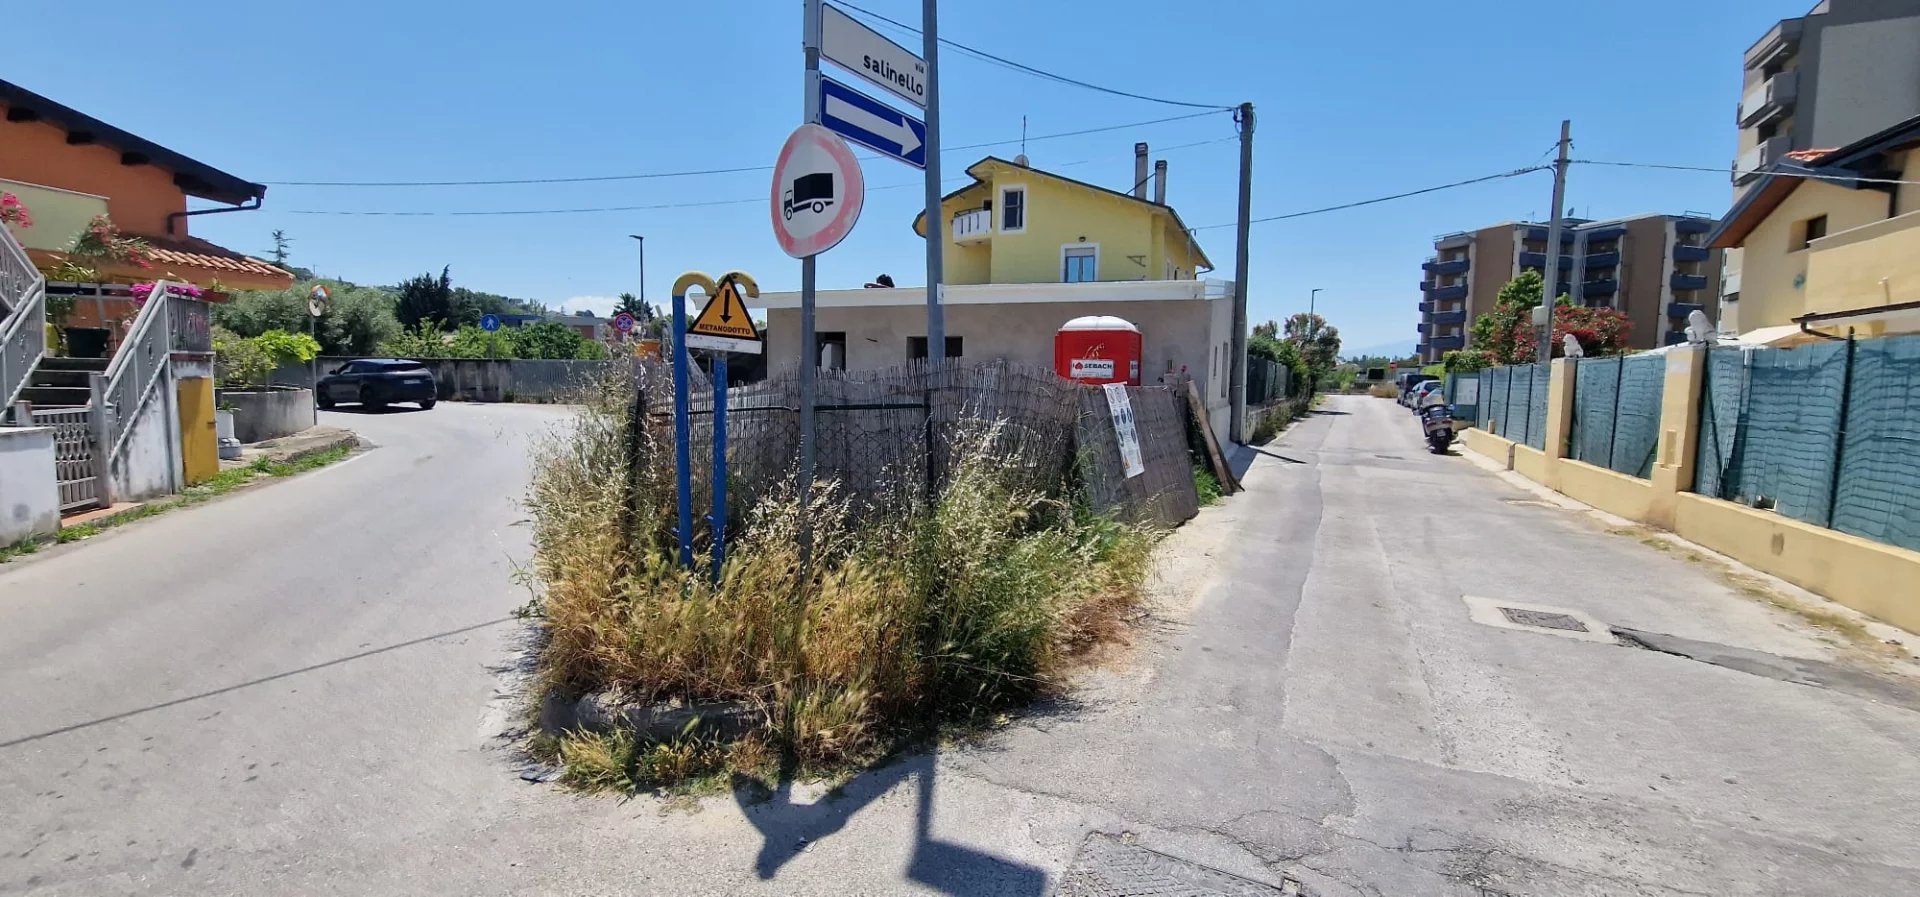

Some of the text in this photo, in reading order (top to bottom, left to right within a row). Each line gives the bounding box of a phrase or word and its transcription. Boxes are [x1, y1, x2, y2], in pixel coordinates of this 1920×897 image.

[914, 62, 924, 74] via
[863, 55, 923, 96] salinello
[699, 323, 750, 335] METANODOTTO
